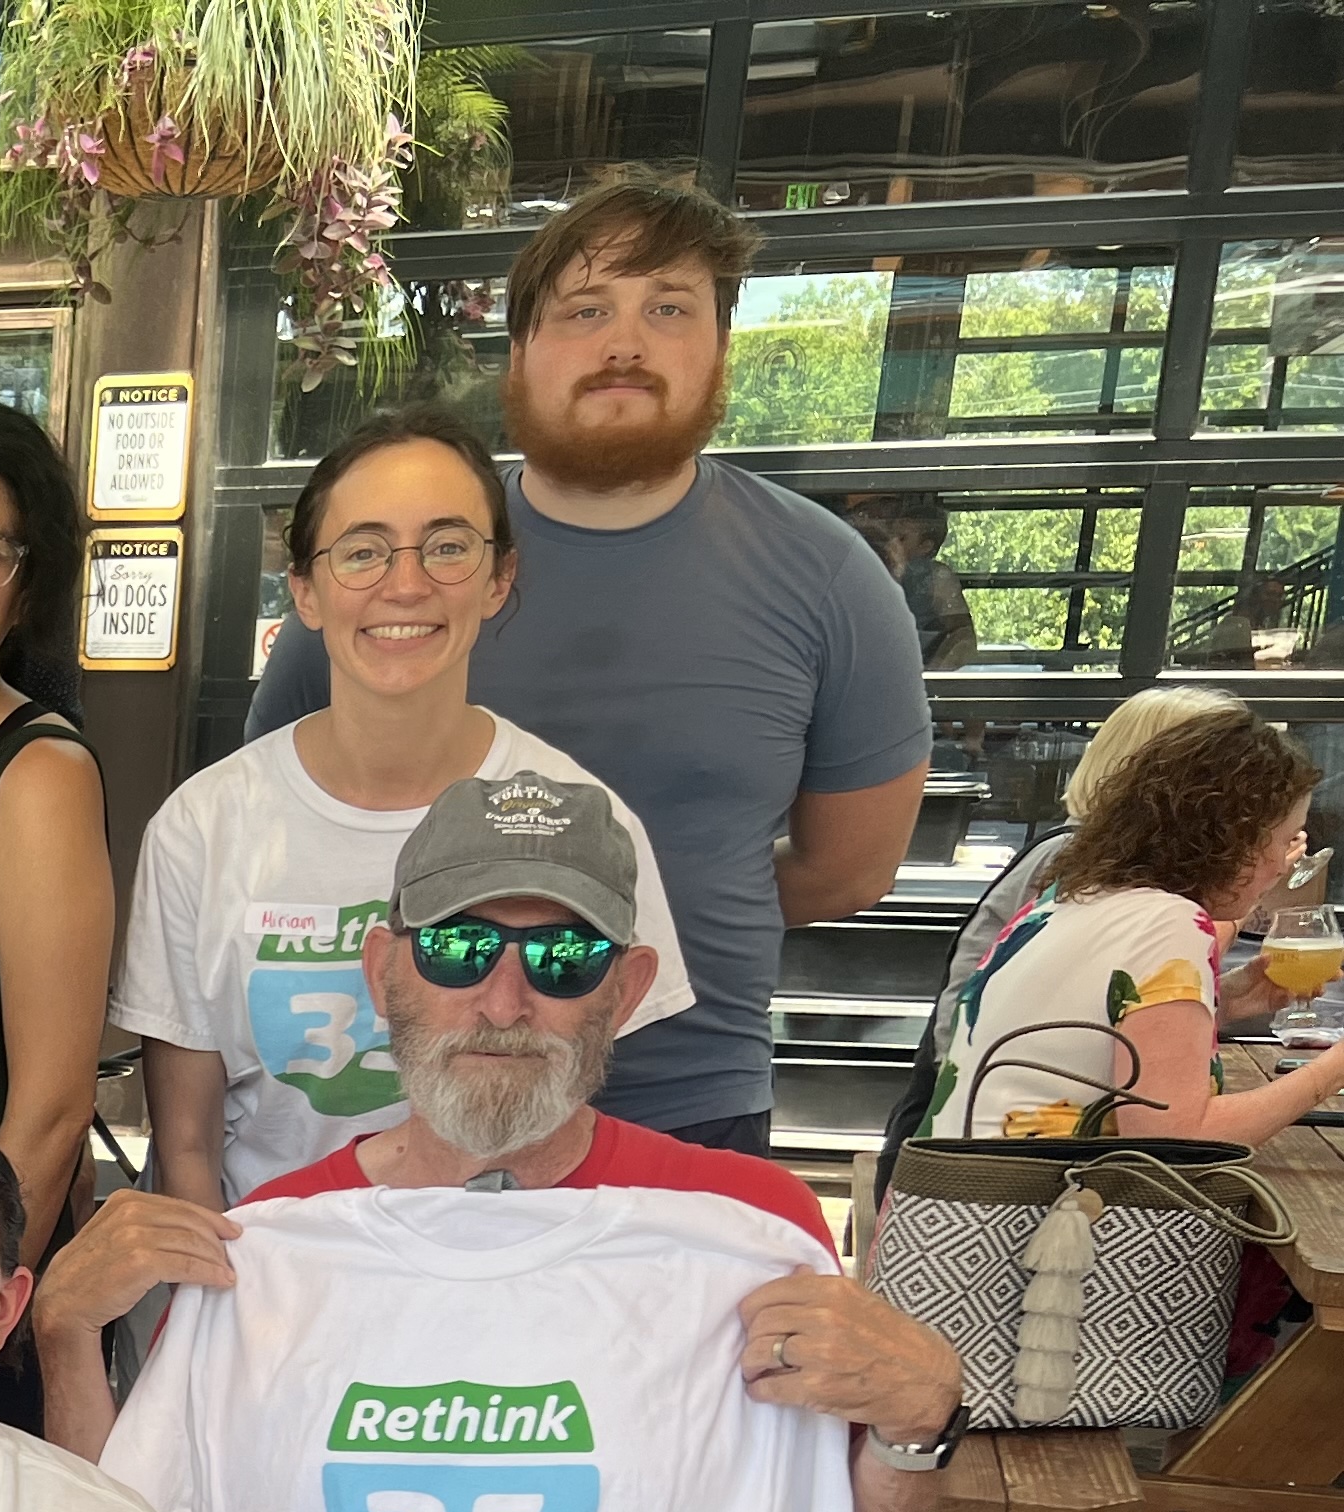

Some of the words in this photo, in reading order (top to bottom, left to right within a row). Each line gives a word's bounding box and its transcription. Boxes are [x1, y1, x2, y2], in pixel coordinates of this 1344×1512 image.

[119, 388, 178, 403] NOTICE
[108, 413, 123, 430] NO
[127, 412, 175, 429] OUTSIDE
[116, 433, 145, 449] FOOD
[149, 433, 165, 449] OR
[118, 454, 159, 470] DRINKS
[110, 474, 164, 490] ALLOWED
[110, 544, 169, 556] NOTICE
[110, 564, 154, 584] Sorry
[98, 584, 118, 607] NO
[125, 584, 167, 607] DOGS
[103, 612, 157, 635] INSIDE
[346, 1394, 577, 1443] Rethink
